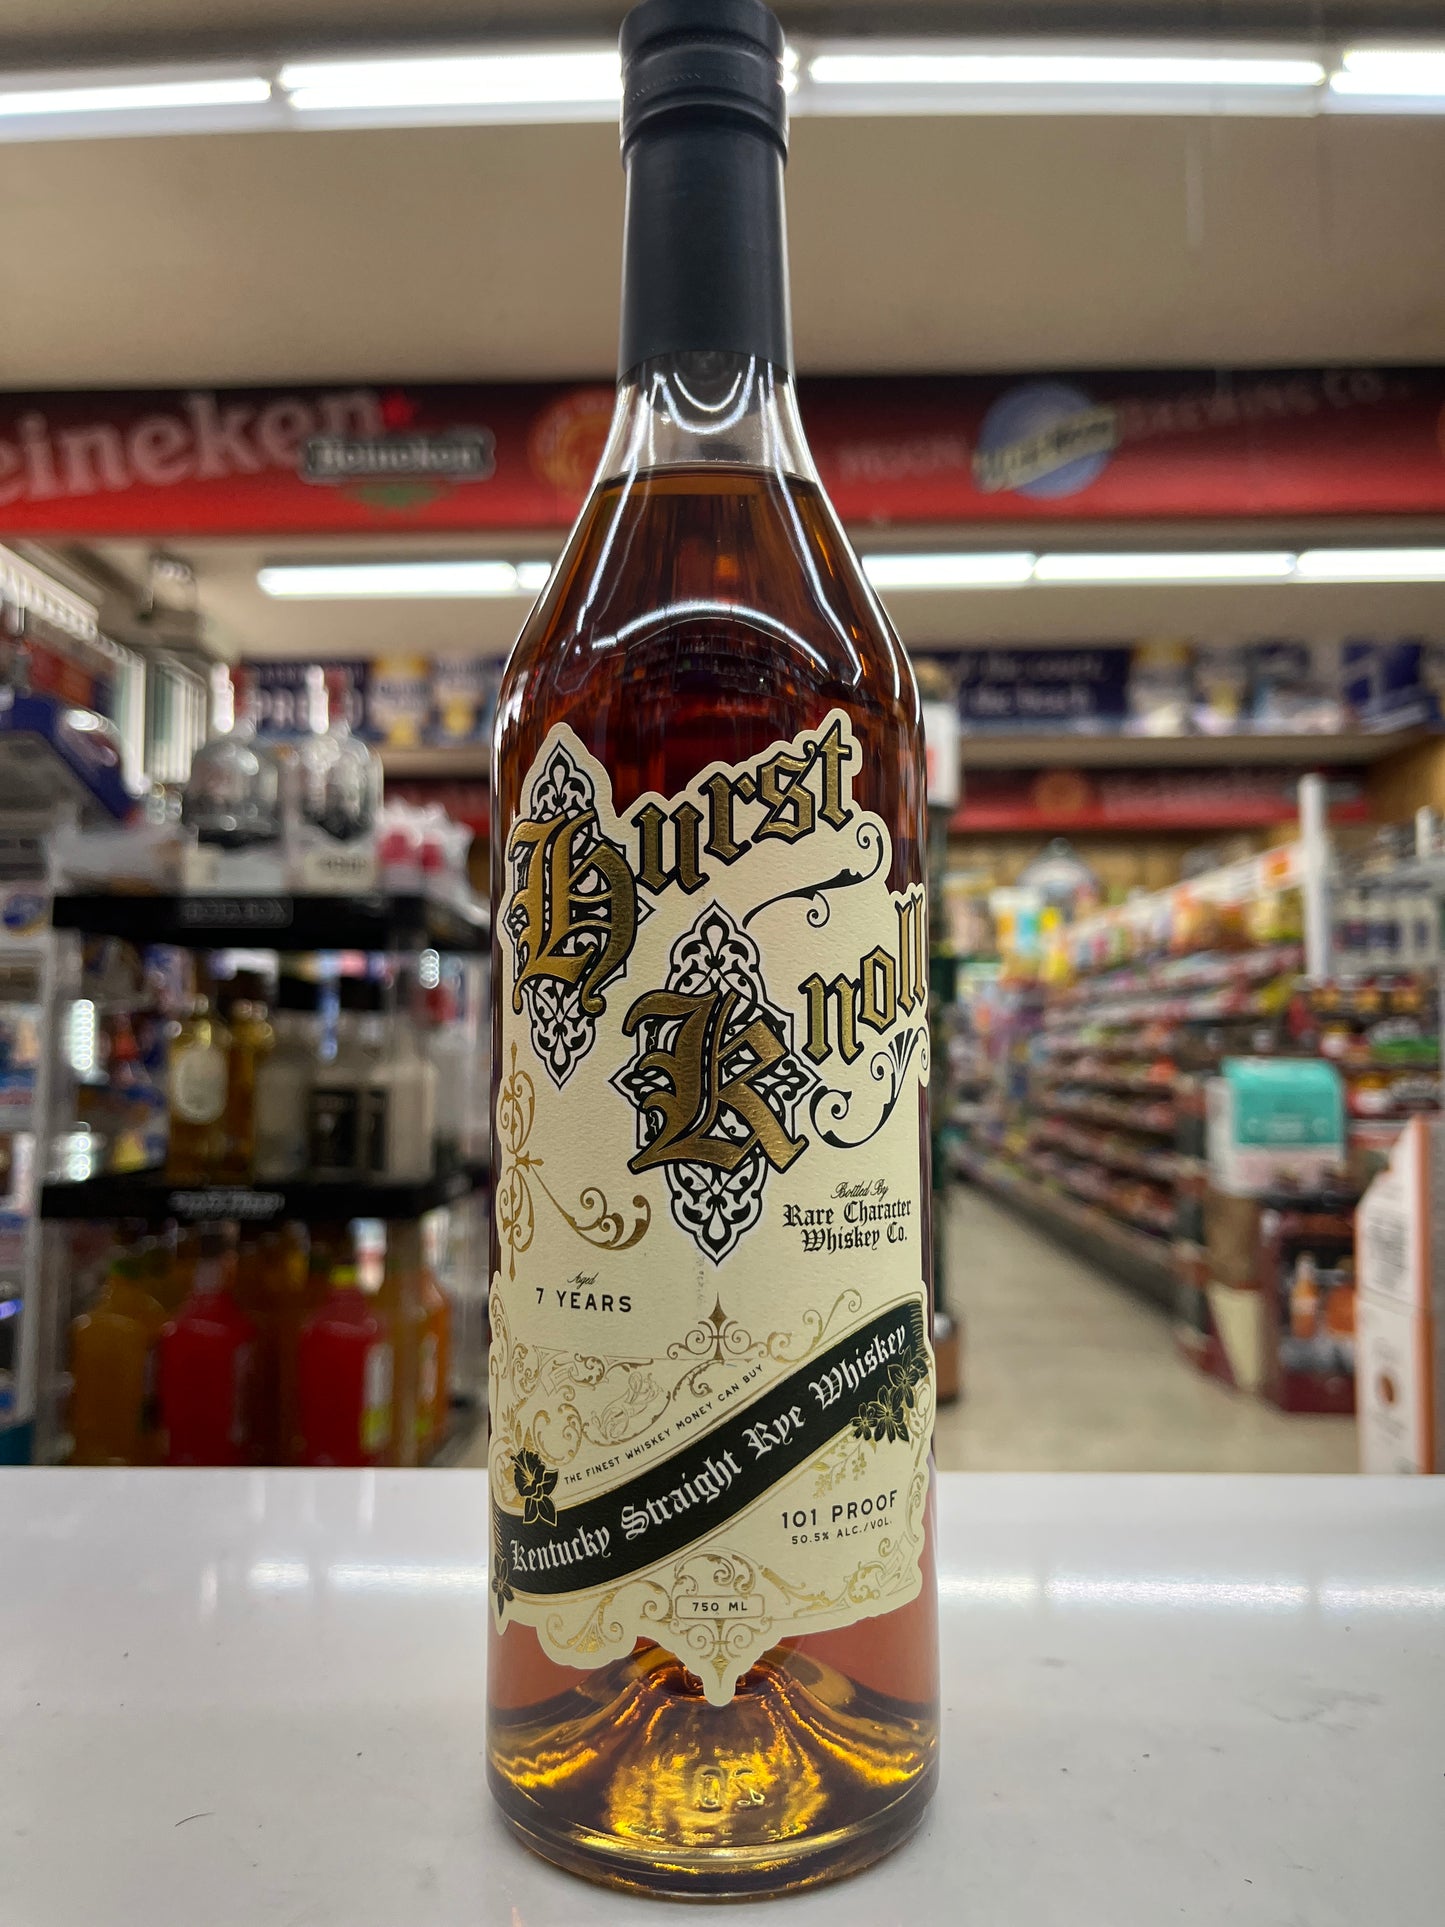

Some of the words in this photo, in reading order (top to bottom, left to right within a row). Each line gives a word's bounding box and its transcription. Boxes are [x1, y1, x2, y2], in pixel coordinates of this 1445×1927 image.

[509, 719, 854, 1015] Hurst
[622, 892, 926, 1175] Knoll
[830, 1180, 873, 1199] Bottled
[870, 1179, 889, 1201] By
[783, 1204, 834, 1227] Rare
[844, 1199, 911, 1226] Character
[801, 1226, 880, 1255] Whiskey
[887, 1222, 907, 1243] Co.
[567, 1271, 599, 1289] Aged
[536, 1287, 544, 1304] 7
[556, 1290, 632, 1312] YEARS
[564, 1471, 582, 1485] THE
[586, 1456, 620, 1477] FINEST
[625, 1428, 671, 1460] WHISKEY
[676, 1401, 713, 1430] MONEY
[717, 1385, 740, 1402] CAN
[742, 1364, 763, 1383] BUY
[509, 1525, 612, 1573] Kentucky
[621, 1449, 742, 1541] Straight
[741, 1405, 806, 1460] Rye
[808, 1324, 906, 1410] Whiskey
[781, 1508, 816, 1528] 101
[832, 1489, 898, 1523] PROOF
[791, 1531, 829, 1545] 50.5%
[836, 1516, 892, 1538] ALC./VOL.
[692, 1602, 719, 1612] 750
[728, 1601, 748, 1611] ML
